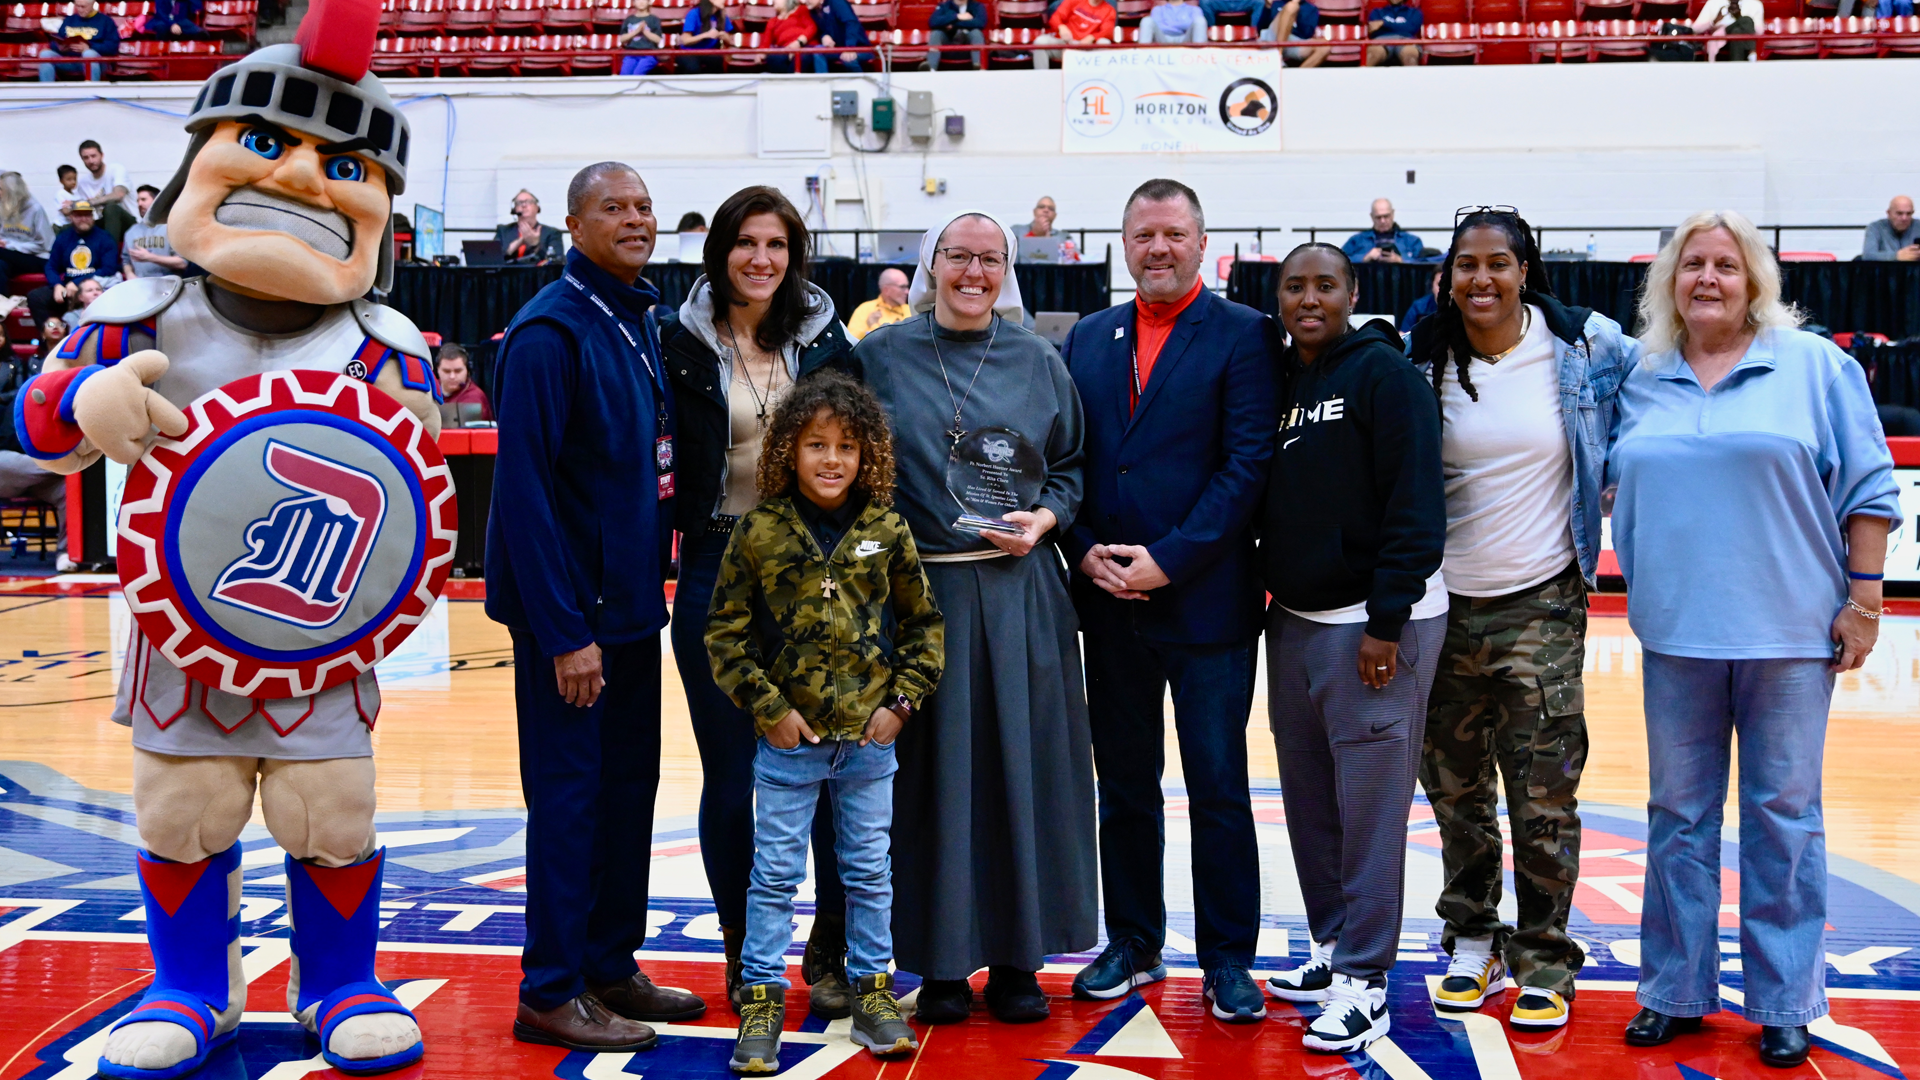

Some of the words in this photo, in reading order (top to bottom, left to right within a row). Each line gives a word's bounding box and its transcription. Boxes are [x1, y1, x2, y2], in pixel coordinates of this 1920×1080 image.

[1075, 56, 1101, 66] WE
[1108, 54, 1139, 65] ARE
[1144, 54, 1175, 65] ALL
[1181, 53, 1217, 65] ONE
[1226, 55, 1270, 65] TEAM
[1082, 95, 1110, 115] 1HL
[1135, 103, 1207, 115] HORIZON
[348, 363, 363, 378] EC
[860, 540, 881, 550] NIKE
